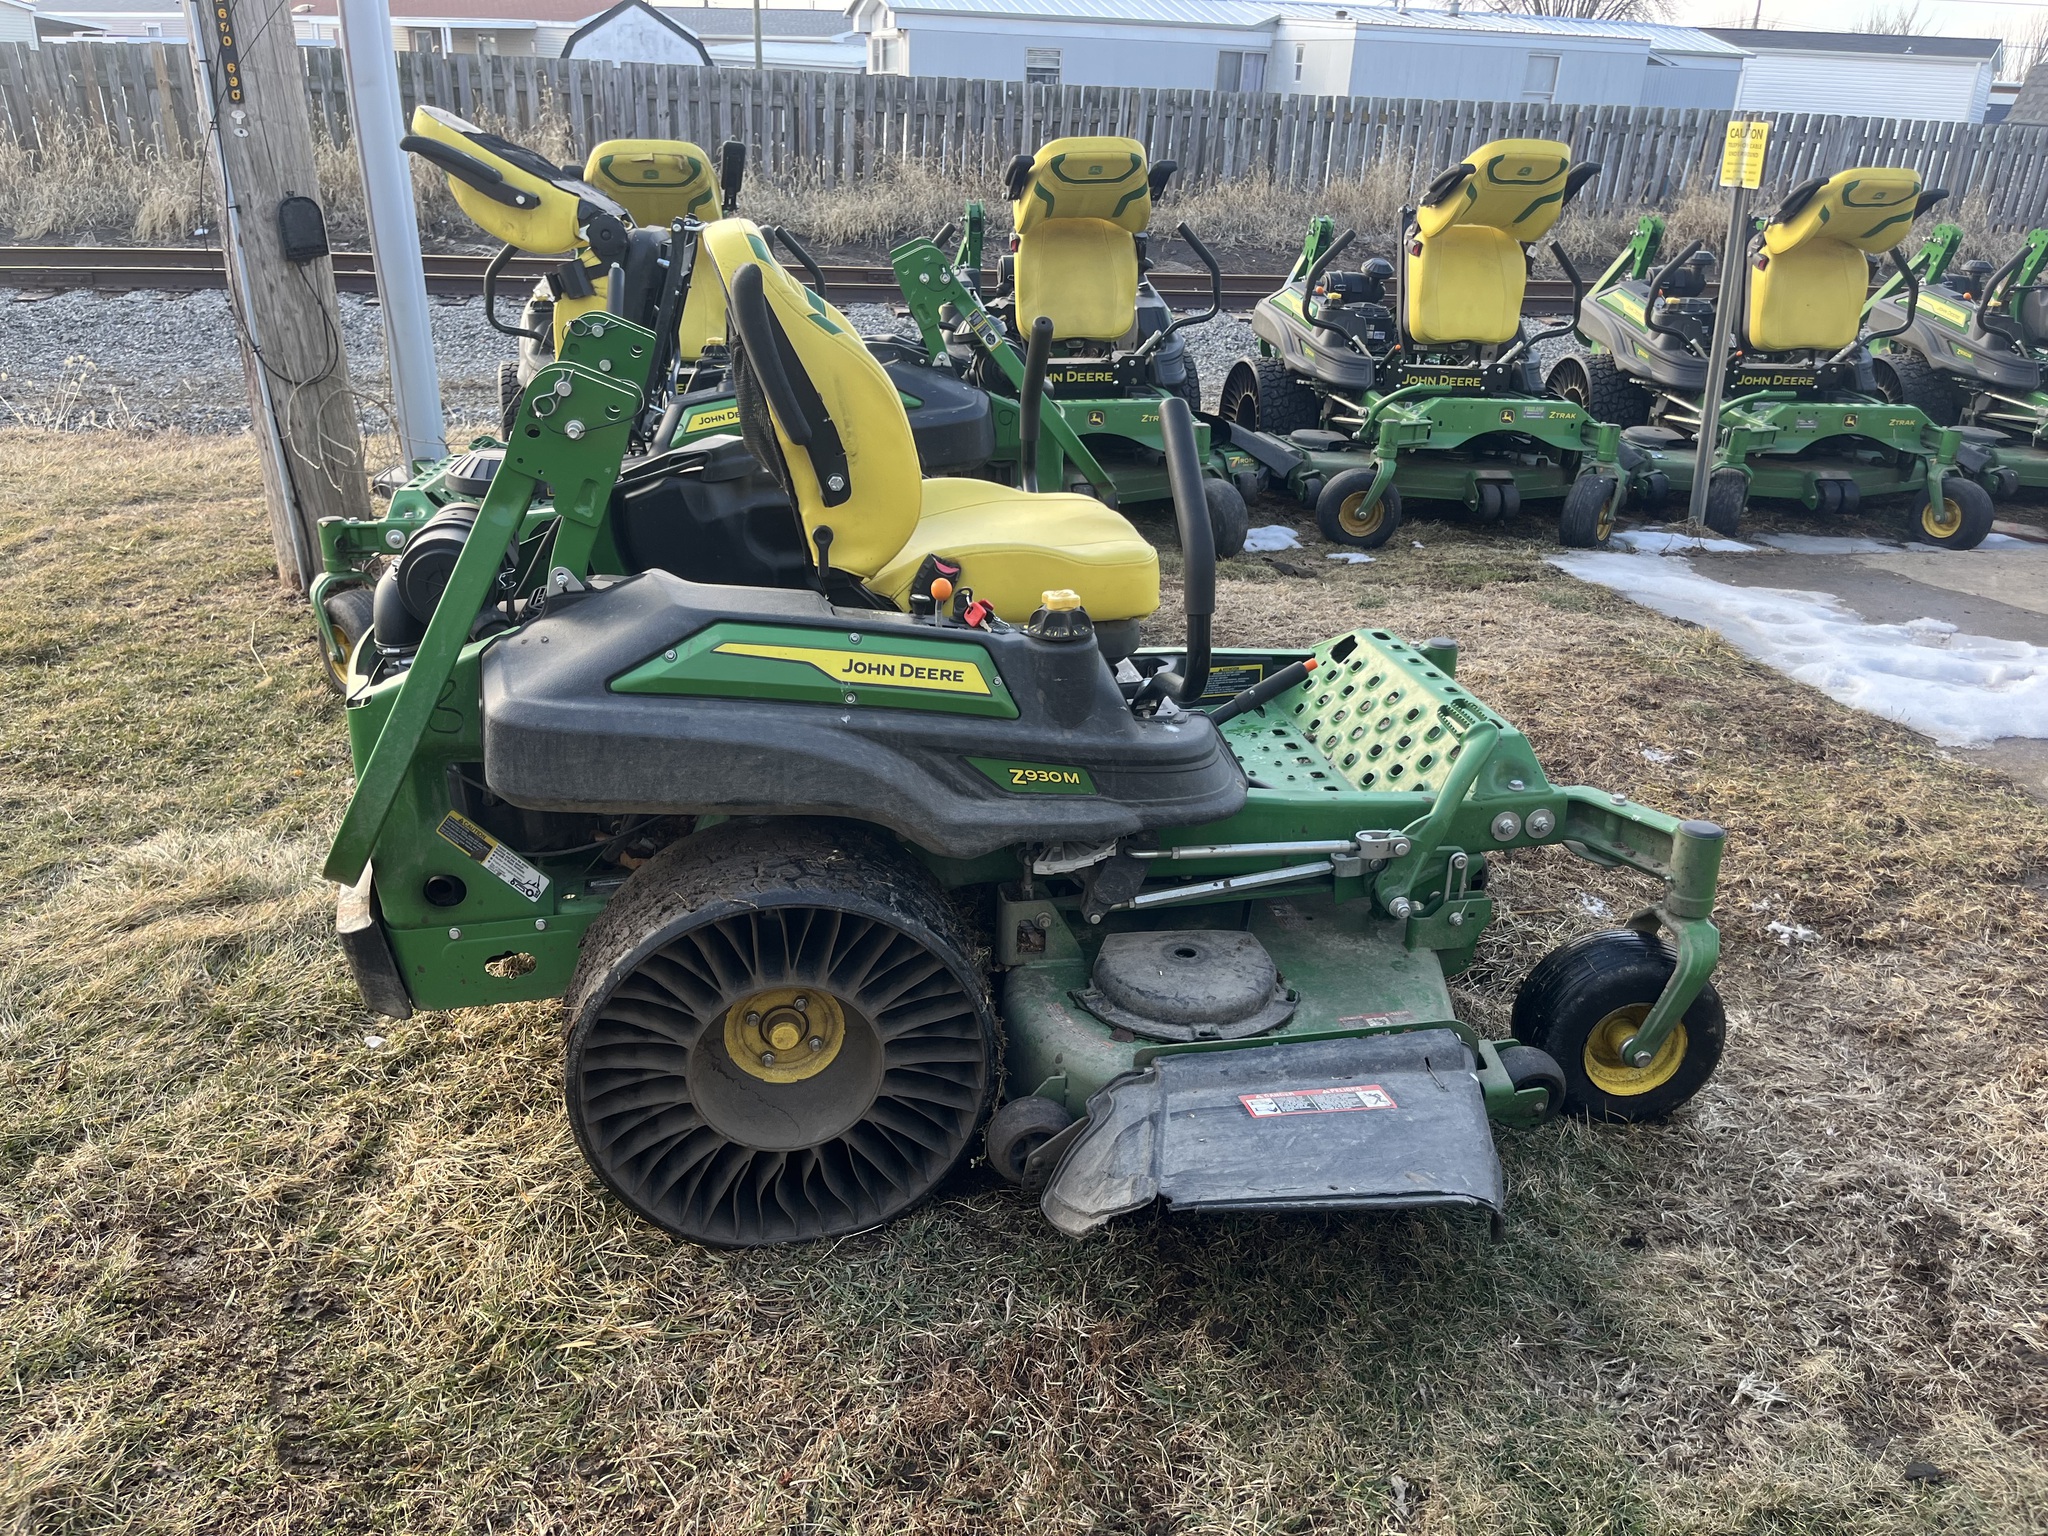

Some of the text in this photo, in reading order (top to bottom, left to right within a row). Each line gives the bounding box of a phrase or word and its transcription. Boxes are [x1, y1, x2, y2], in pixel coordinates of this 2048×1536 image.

[226, 63, 241, 100] 690
[1730, 127, 1764, 140] CAUON
[1066, 371, 1113, 383] DEERE
[1402, 374, 1481, 387] JOHN DEERE
[1736, 375, 1815, 386] JOHN DEERE
[699, 414, 725, 425] JOHN
[1141, 414, 1159, 422] ZTR
[1549, 411, 1576, 419] ZTRAK
[1888, 418, 1916, 427] ZTRAK
[842, 658, 964, 682] JOHN DEERE
[1009, 768, 1080, 785] Z930M
[463, 821, 487, 840] CAUTION
